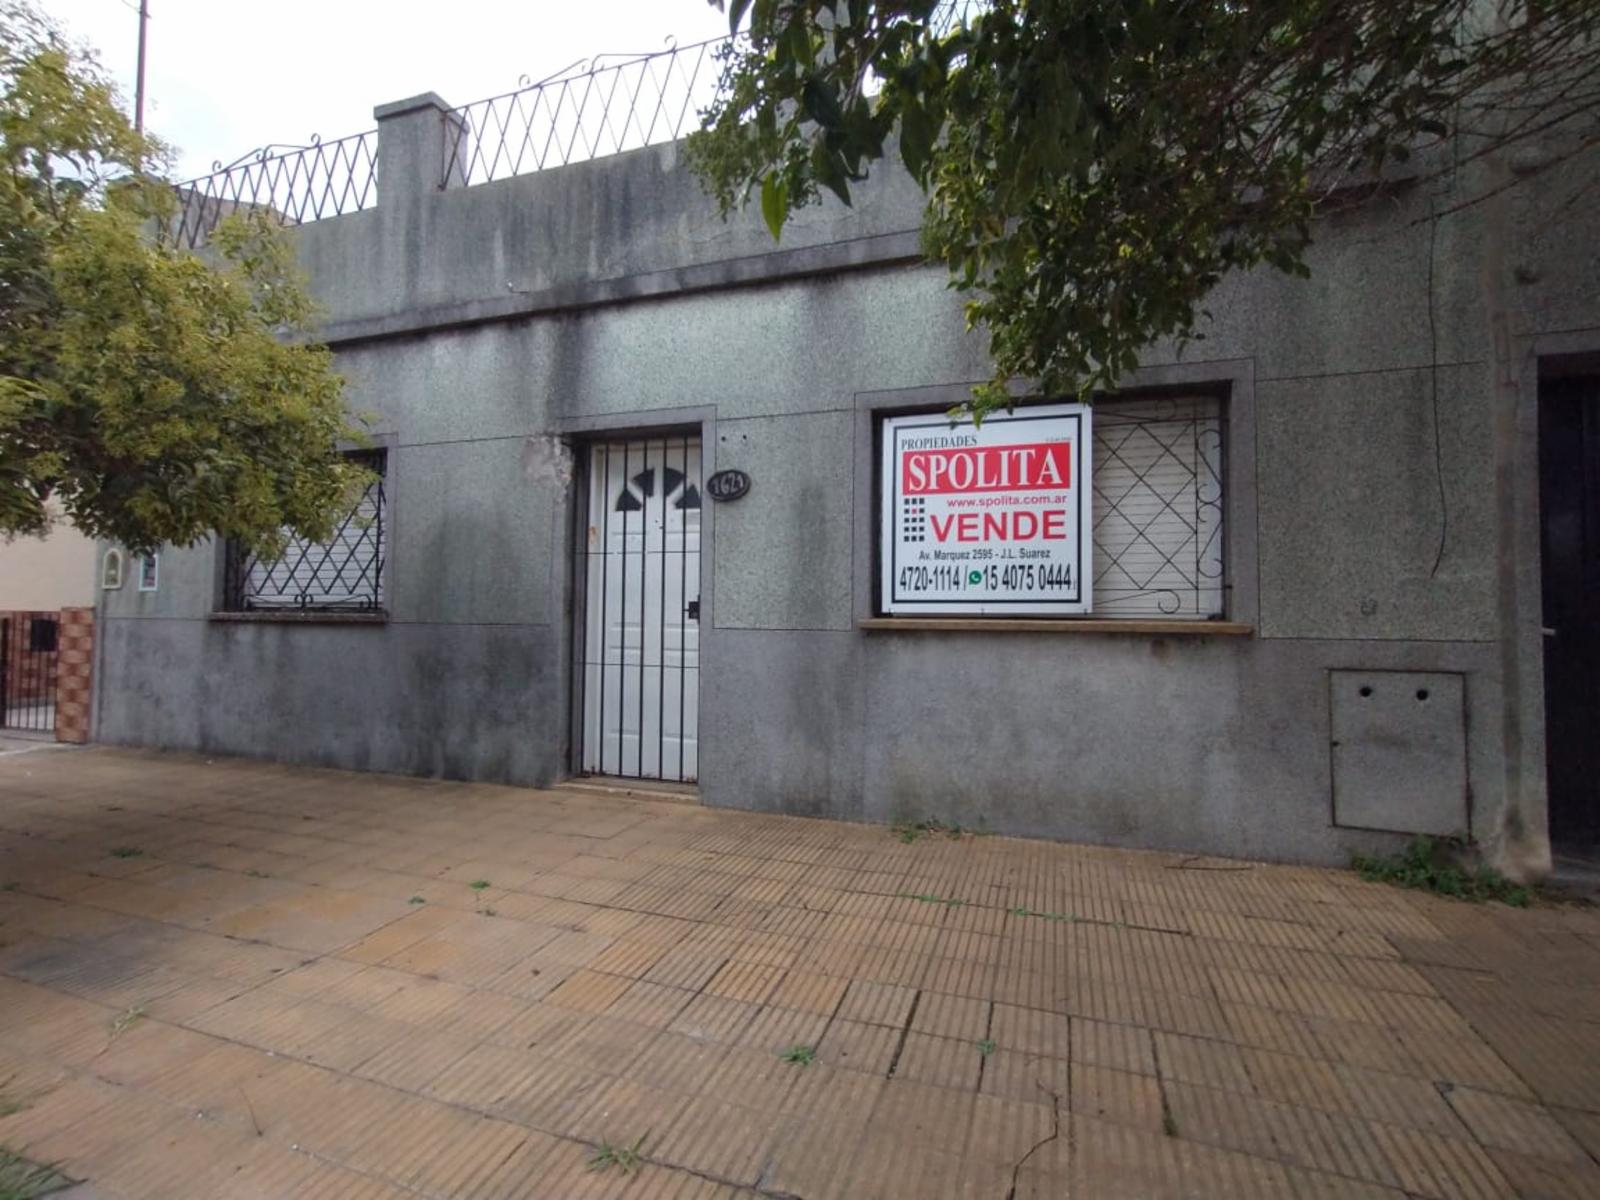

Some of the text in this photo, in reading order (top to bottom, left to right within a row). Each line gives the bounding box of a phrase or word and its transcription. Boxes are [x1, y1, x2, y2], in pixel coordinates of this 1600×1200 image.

[901, 434, 978, 450] PROPIEDADES
[909, 448, 1063, 492] SPOLITA
[946, 494, 1067, 509] www.spolita.com.ar
[930, 509, 1067, 543] VENDE
[919, 550, 931, 560] Av.
[934, 549, 970, 562] Marquez
[972, 548, 993, 560] 2595
[1000, 548, 1018, 559] J.L.
[1019, 547, 1051, 559] Suarez
[899, 564, 960, 591] 4720-1114
[984, 565, 998, 591] 15
[1002, 564, 1035, 591] 4075
[1039, 563, 1072, 591] 0444
